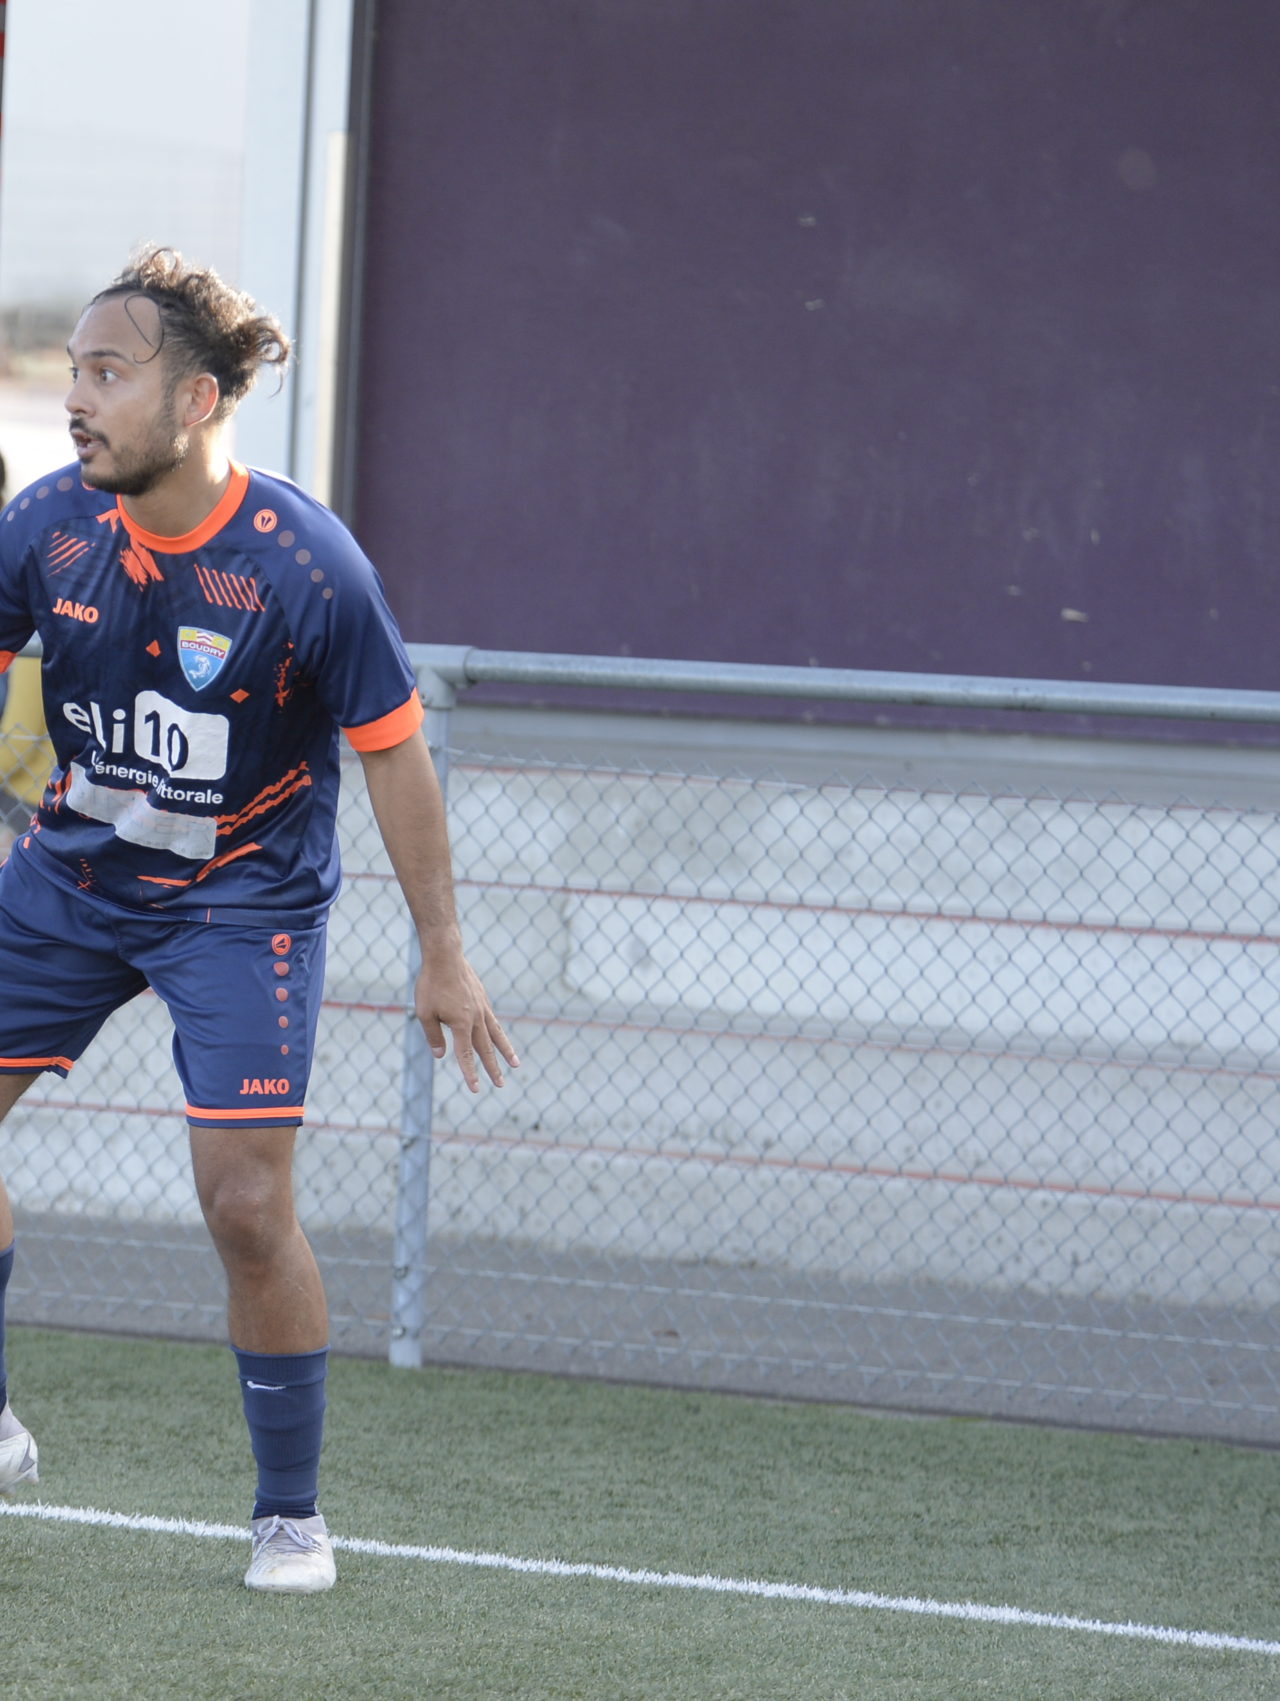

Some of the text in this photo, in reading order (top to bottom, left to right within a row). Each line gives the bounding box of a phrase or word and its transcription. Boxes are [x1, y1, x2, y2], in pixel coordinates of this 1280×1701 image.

[53, 598, 99, 623] JAKO
[181, 641, 225, 658] BOUDRY
[239, 1078, 290, 1095] JAKO
